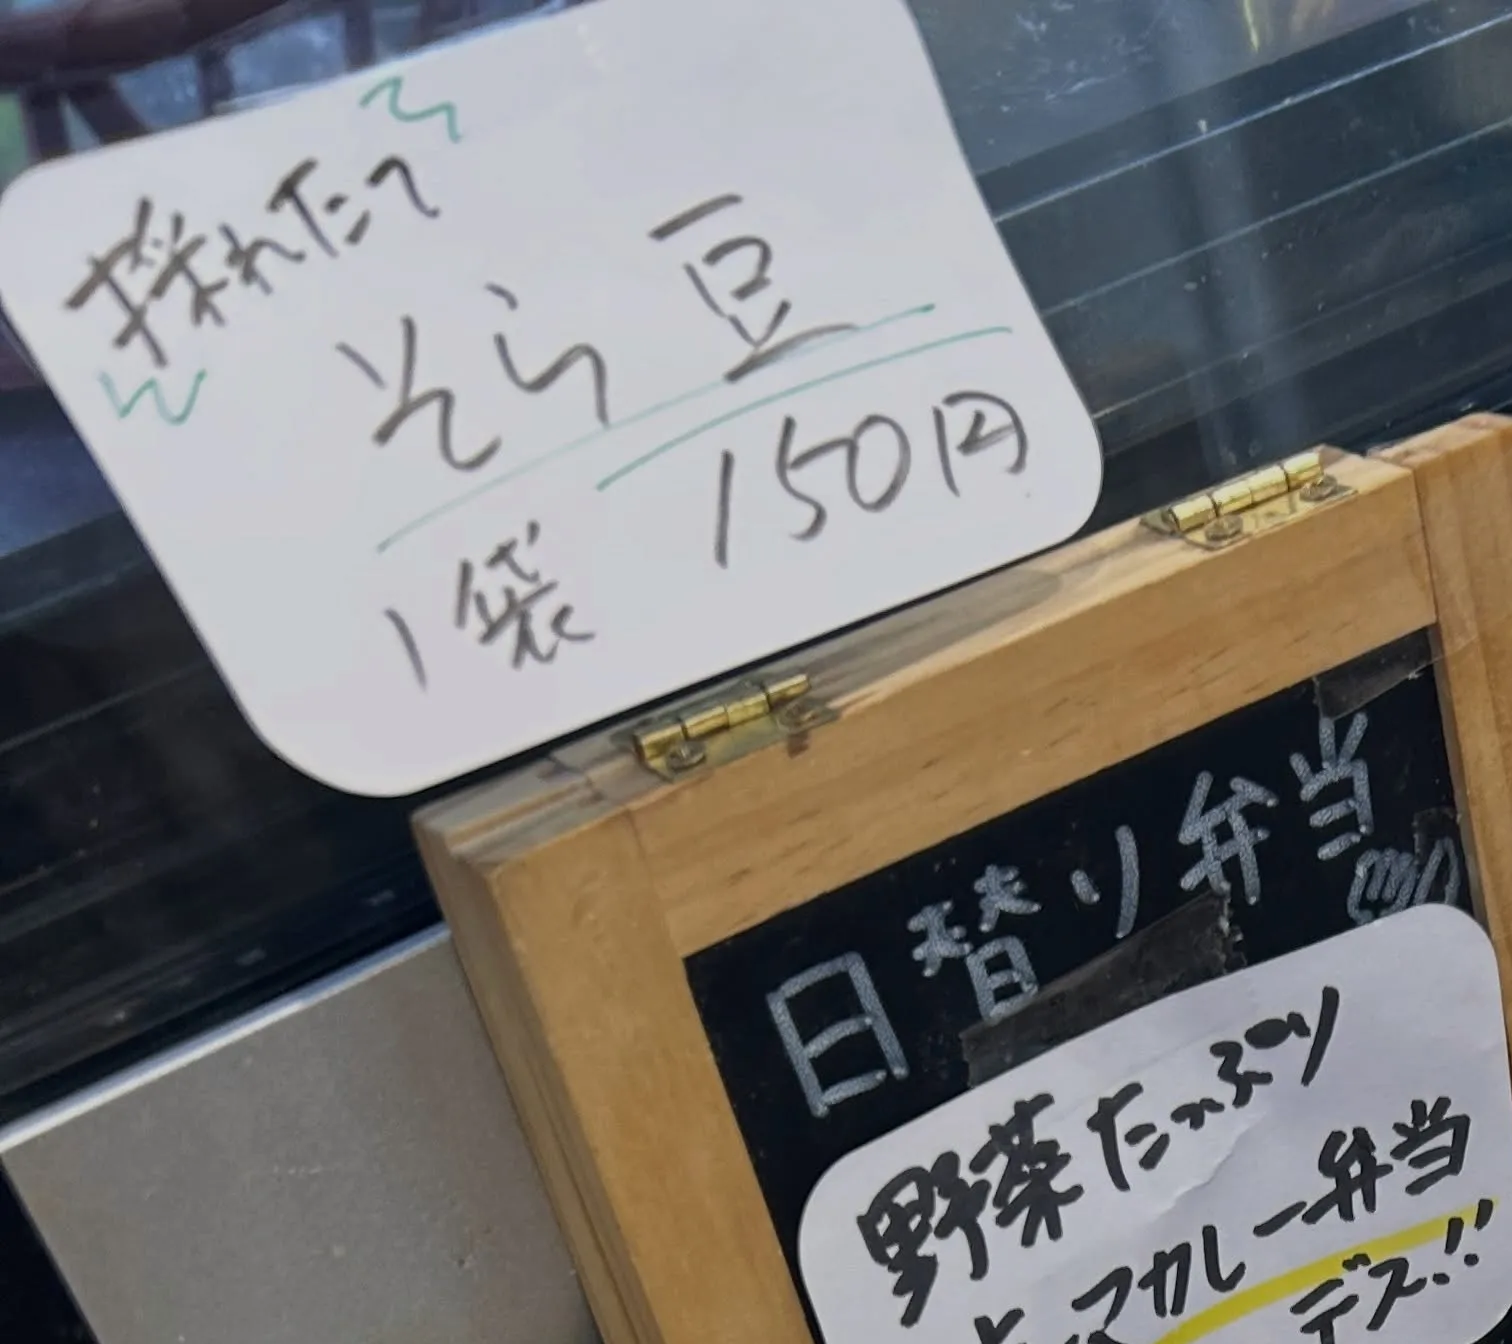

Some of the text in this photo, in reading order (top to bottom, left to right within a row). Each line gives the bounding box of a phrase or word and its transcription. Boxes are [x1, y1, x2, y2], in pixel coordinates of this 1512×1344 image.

[717, 391, 1027, 568] 150円
[767, 711, 1374, 1119] 日替り弁当
[857, 987, 1342, 1328] 野菜たっぷり
